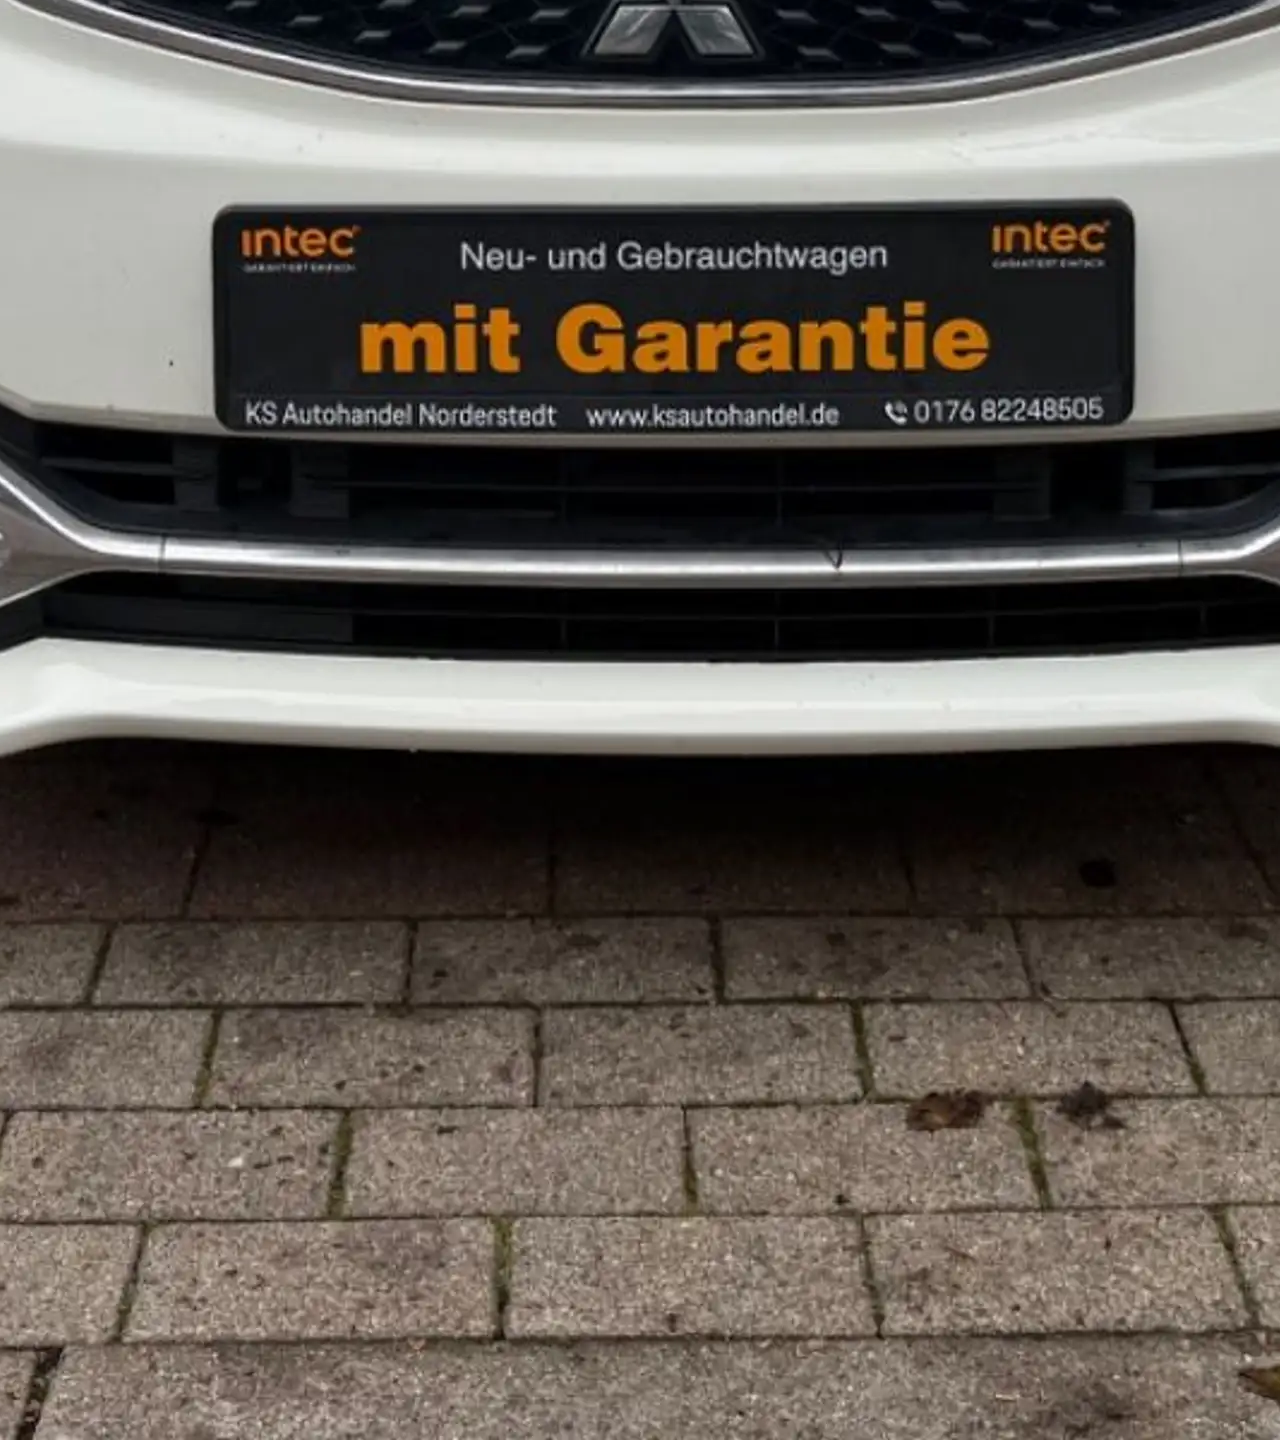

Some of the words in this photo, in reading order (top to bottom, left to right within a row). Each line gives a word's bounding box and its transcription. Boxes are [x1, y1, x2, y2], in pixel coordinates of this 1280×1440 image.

[460, 241, 537, 270] Neu-
[548, 241, 607, 270] und
[616, 240, 889, 275] Gebrauchtwagen
[359, 302, 520, 374] mit
[555, 300, 991, 375] Garantie
[244, 400, 278, 426] KS
[282, 402, 413, 427] Autohandel
[418, 402, 558, 427] Norderstedt
[585, 401, 840, 427] www.ksautohandel.de
[913, 399, 976, 424] 0176
[979, 395, 1105, 422] 82248505
